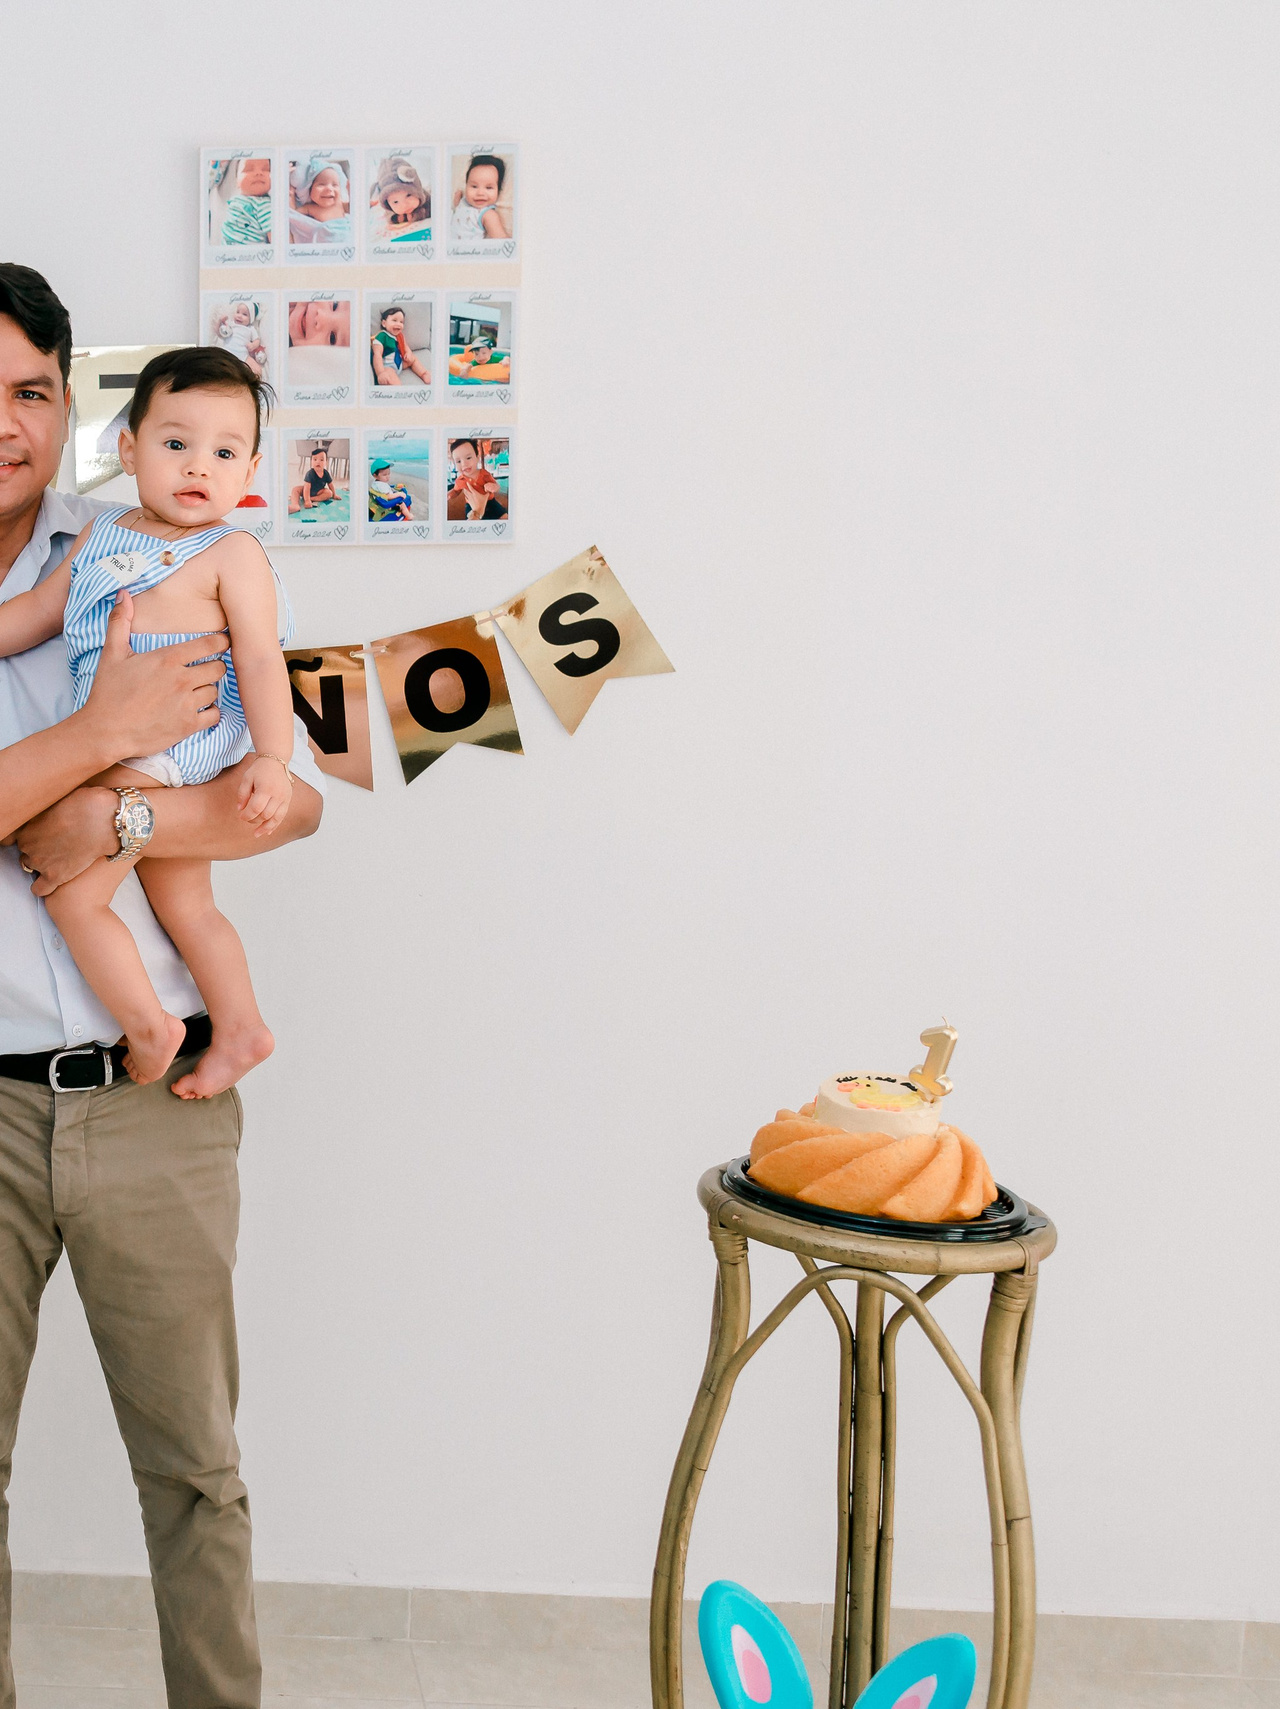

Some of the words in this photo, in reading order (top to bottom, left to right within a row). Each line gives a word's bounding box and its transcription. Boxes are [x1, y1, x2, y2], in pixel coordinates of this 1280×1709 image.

[306, 429, 330, 439] Gabriel
[383, 430, 406, 441] Gabriel
[469, 428, 493, 439] Gabriel
[312, 530, 332, 538] 2024
[390, 527, 410, 535] 2024
[468, 526, 488, 534] 2024
[110, 557, 126, 571] TRUE
